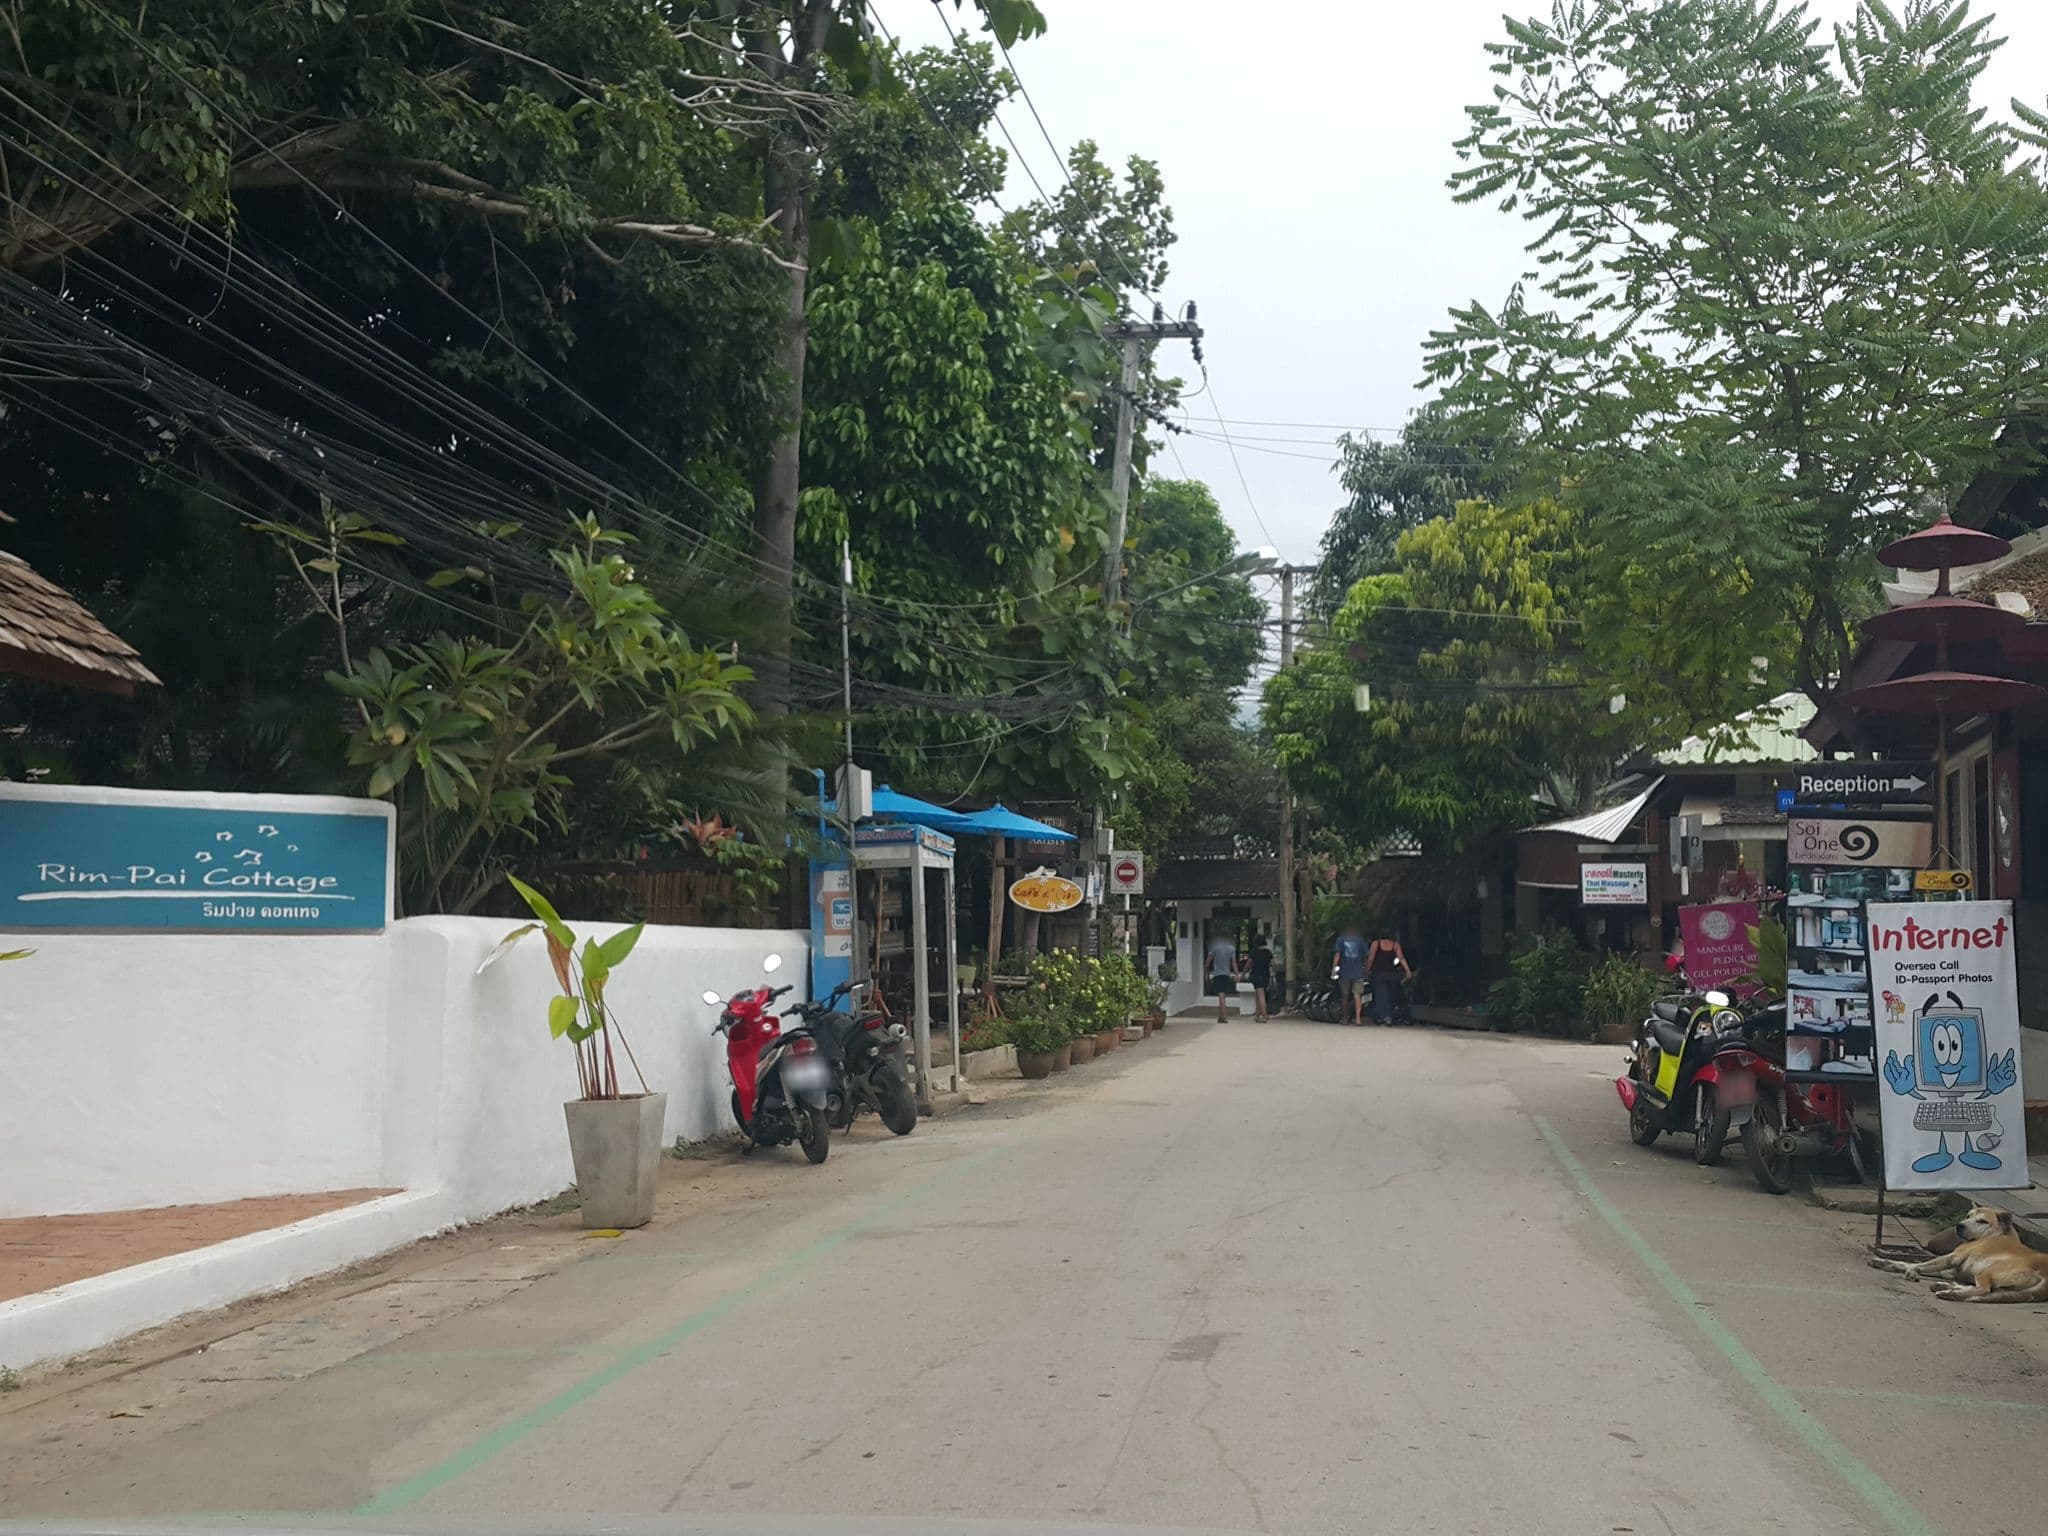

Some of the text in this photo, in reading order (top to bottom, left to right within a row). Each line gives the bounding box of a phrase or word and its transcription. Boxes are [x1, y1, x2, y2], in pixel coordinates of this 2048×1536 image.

[1800, 774, 1890, 796] Reception
[1795, 822, 1820, 836] Soi
[1804, 837, 1839, 851] One
[37, 863, 338, 893] Rim-Pai Cottage
[203, 902, 256, 918] ริมปาย
[1872, 917, 2009, 951] Internet
[1895, 961, 1959, 971] Oversea Call
[1896, 974, 1993, 985] ID-Passport Photos
